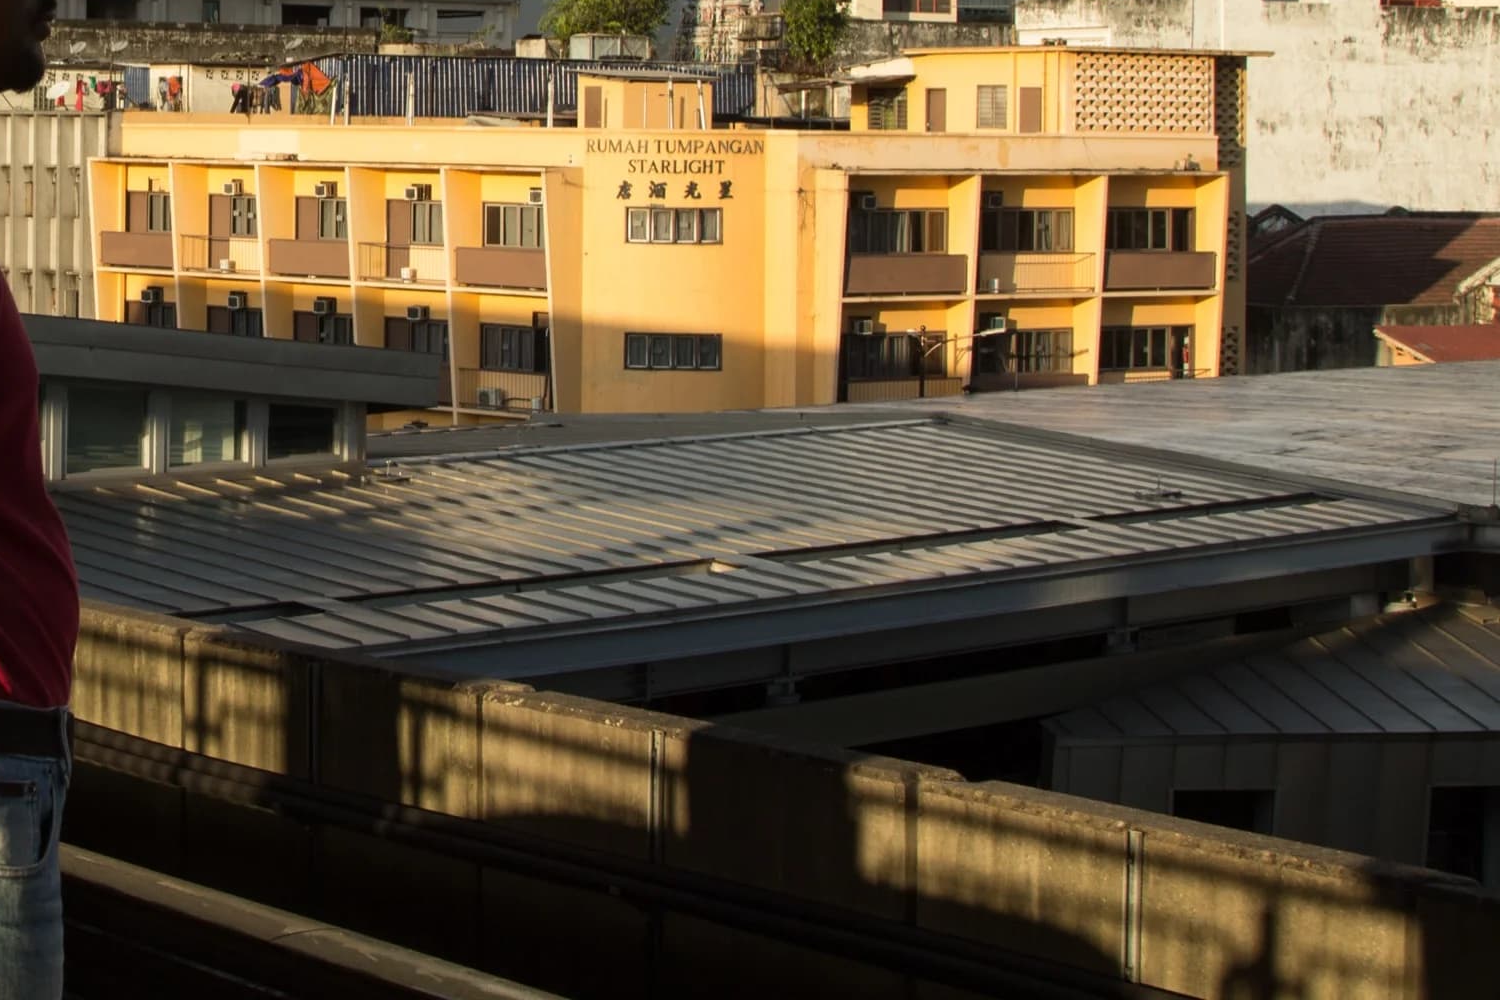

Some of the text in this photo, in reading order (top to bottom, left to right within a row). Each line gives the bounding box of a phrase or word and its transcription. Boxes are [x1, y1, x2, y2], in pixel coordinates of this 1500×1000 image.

[586, 138, 765, 155] RUMAH TUMPANGAN
[627, 158, 726, 175] STARLIGHT
